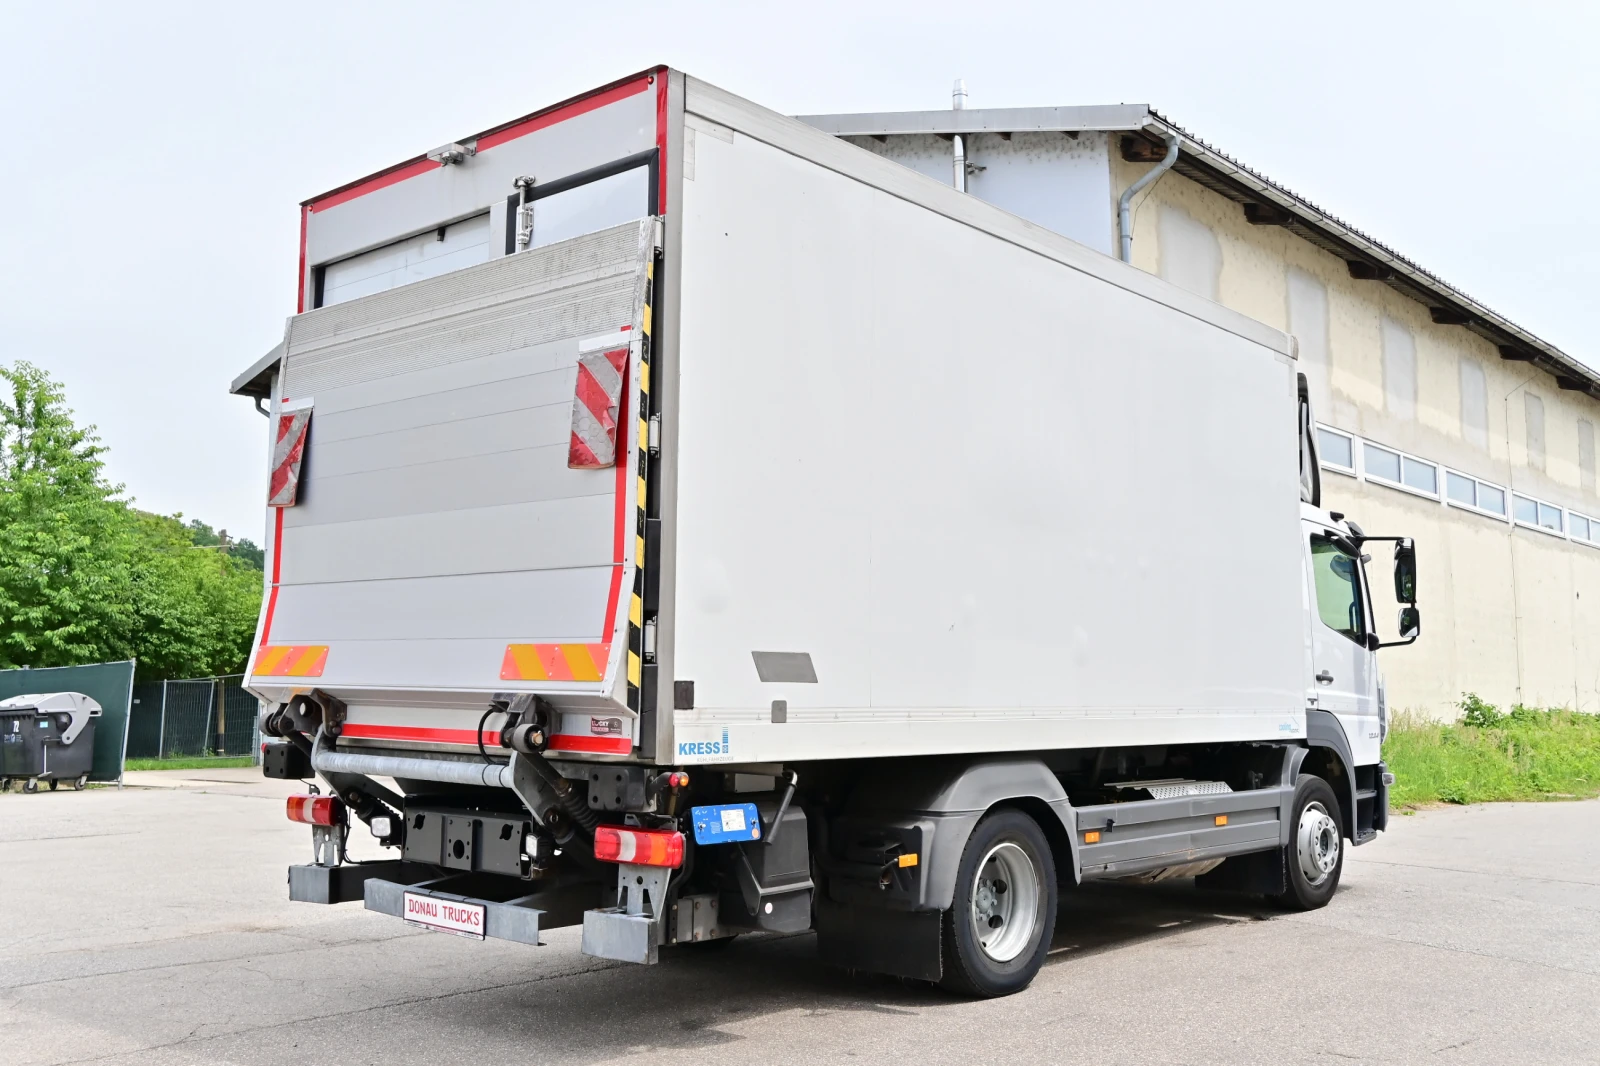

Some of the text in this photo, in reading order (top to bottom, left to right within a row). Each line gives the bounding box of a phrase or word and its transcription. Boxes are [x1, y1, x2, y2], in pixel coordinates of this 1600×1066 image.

[679, 742, 720, 755] KRESS
[408, 898, 480, 926] DONAU TRUCKS
